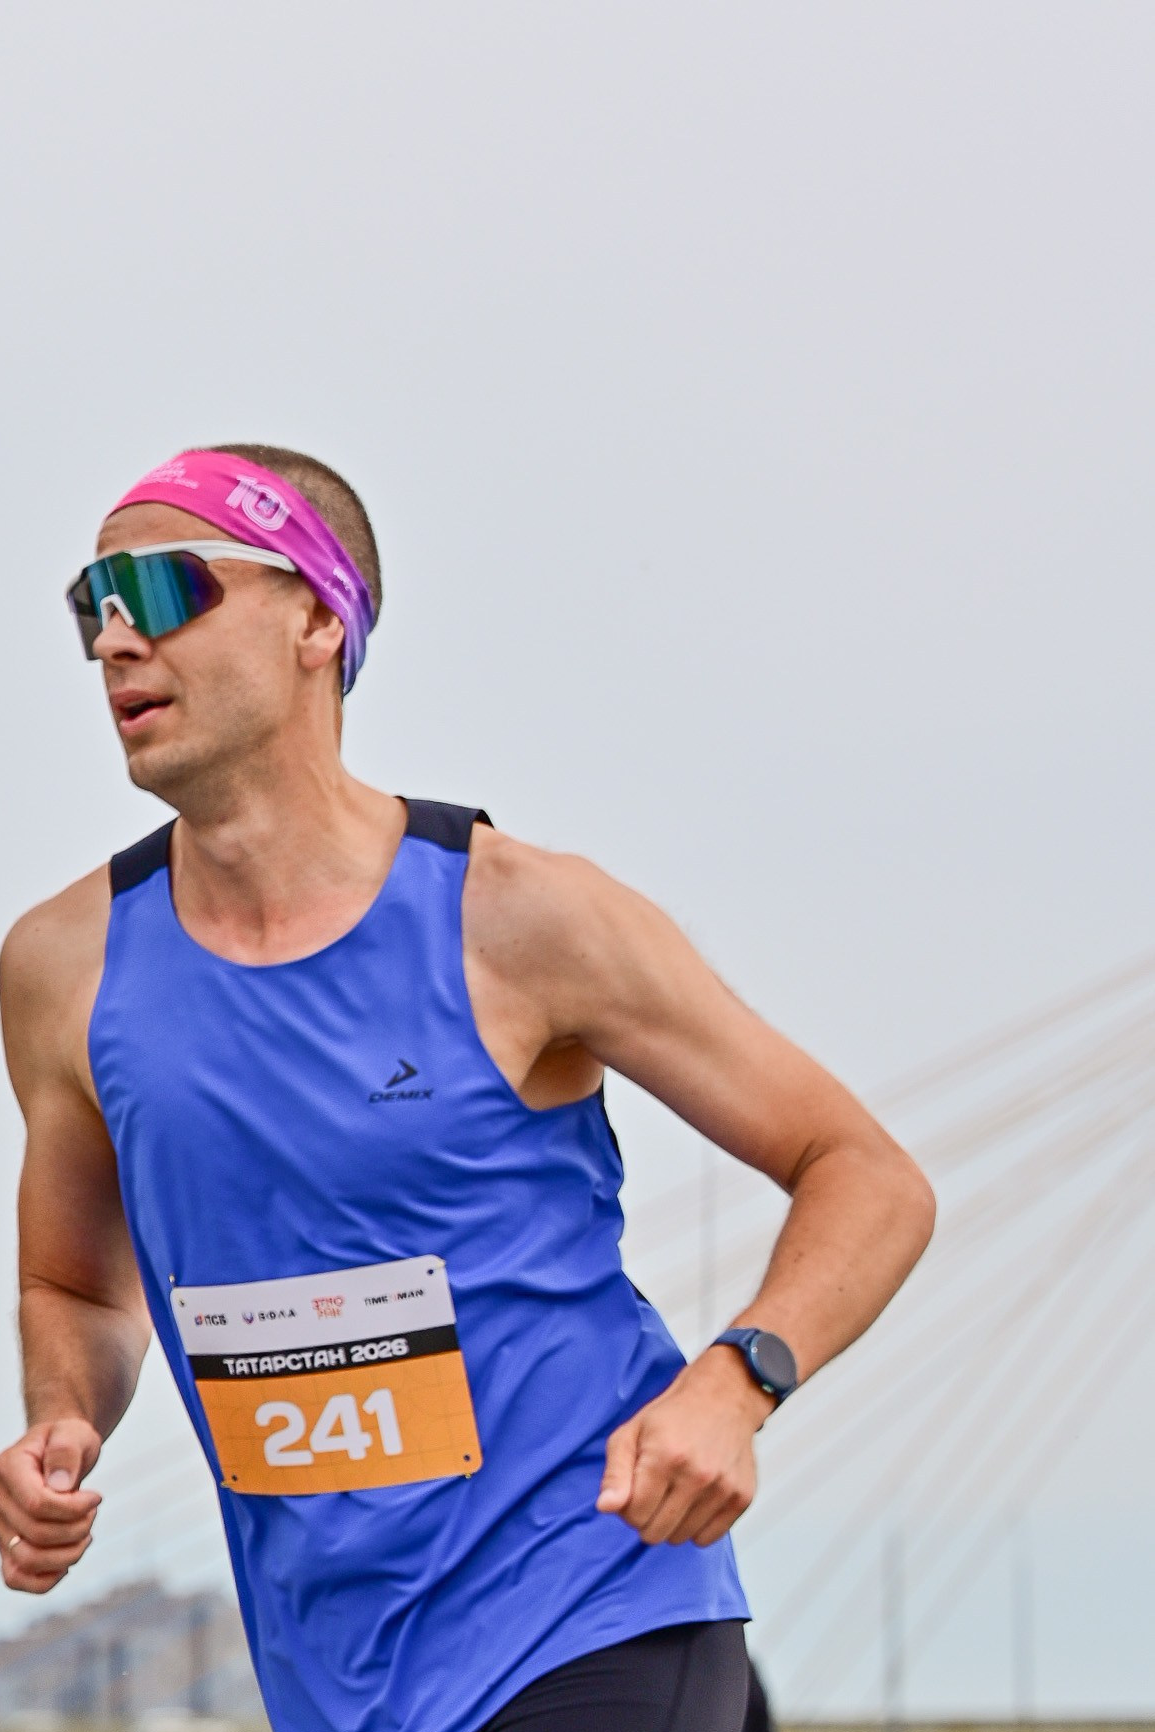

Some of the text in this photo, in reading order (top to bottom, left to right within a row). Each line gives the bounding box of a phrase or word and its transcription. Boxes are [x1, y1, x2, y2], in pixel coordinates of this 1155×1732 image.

[222, 1338, 410, 1376] ТАТАРСТАН 2026
[255, 1387, 403, 1467] 241
